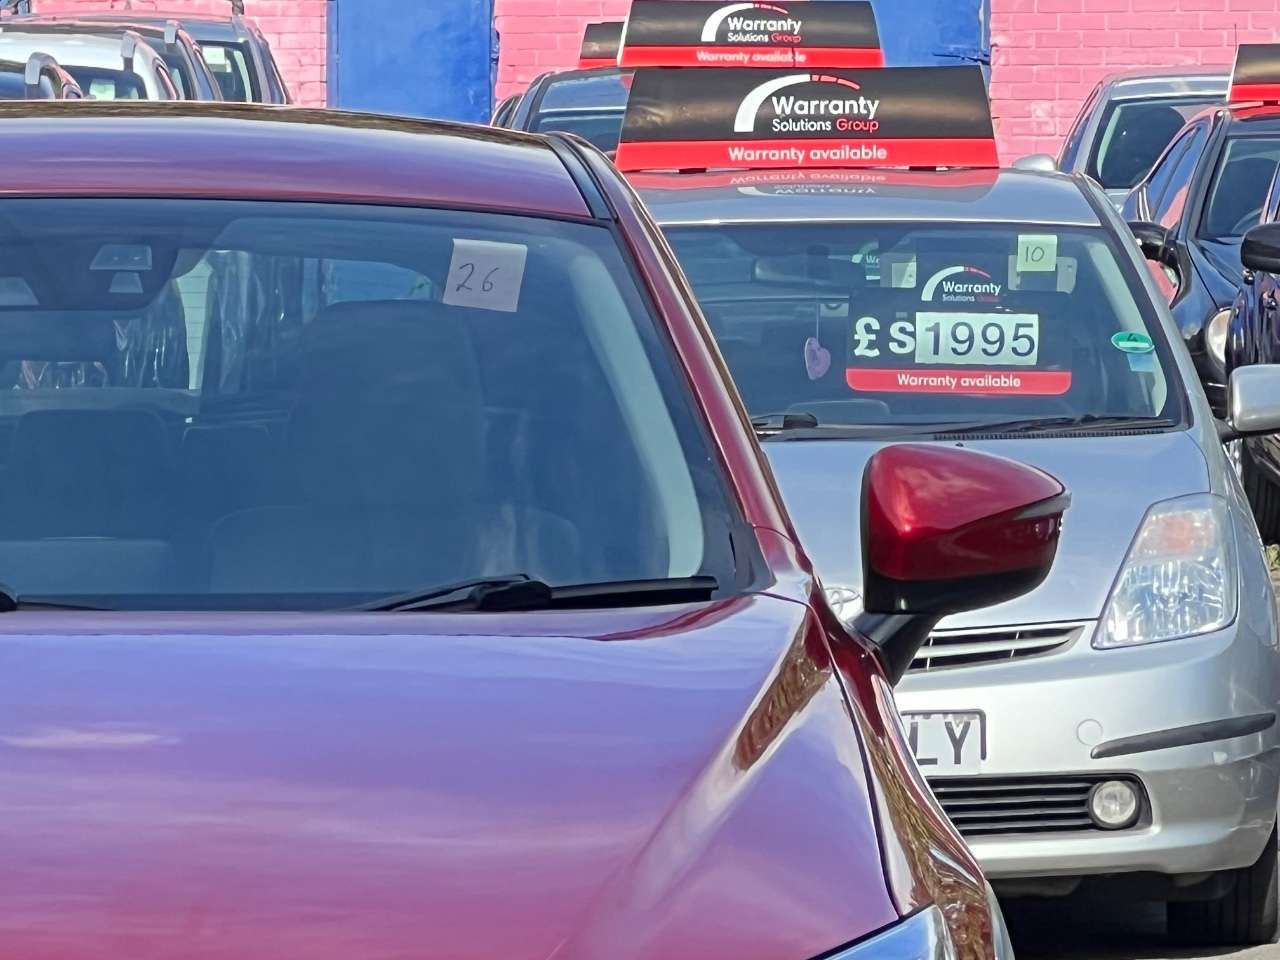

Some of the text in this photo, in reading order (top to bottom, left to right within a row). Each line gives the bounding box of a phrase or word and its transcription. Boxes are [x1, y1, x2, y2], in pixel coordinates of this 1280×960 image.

[727, 16, 802, 35] Warranty
[727, 32, 802, 43] Solutions Group
[696, 50, 749, 64] Warranty
[771, 96, 880, 120] Warranty
[772, 118, 879, 133] Solutions Group
[728, 145, 887, 164] Warranty available
[1025, 246, 1045, 262] 10
[455, 262, 500, 292] 26
[942, 281, 1002, 296] Warranty
[897, 373, 1021, 389] Warranty available
